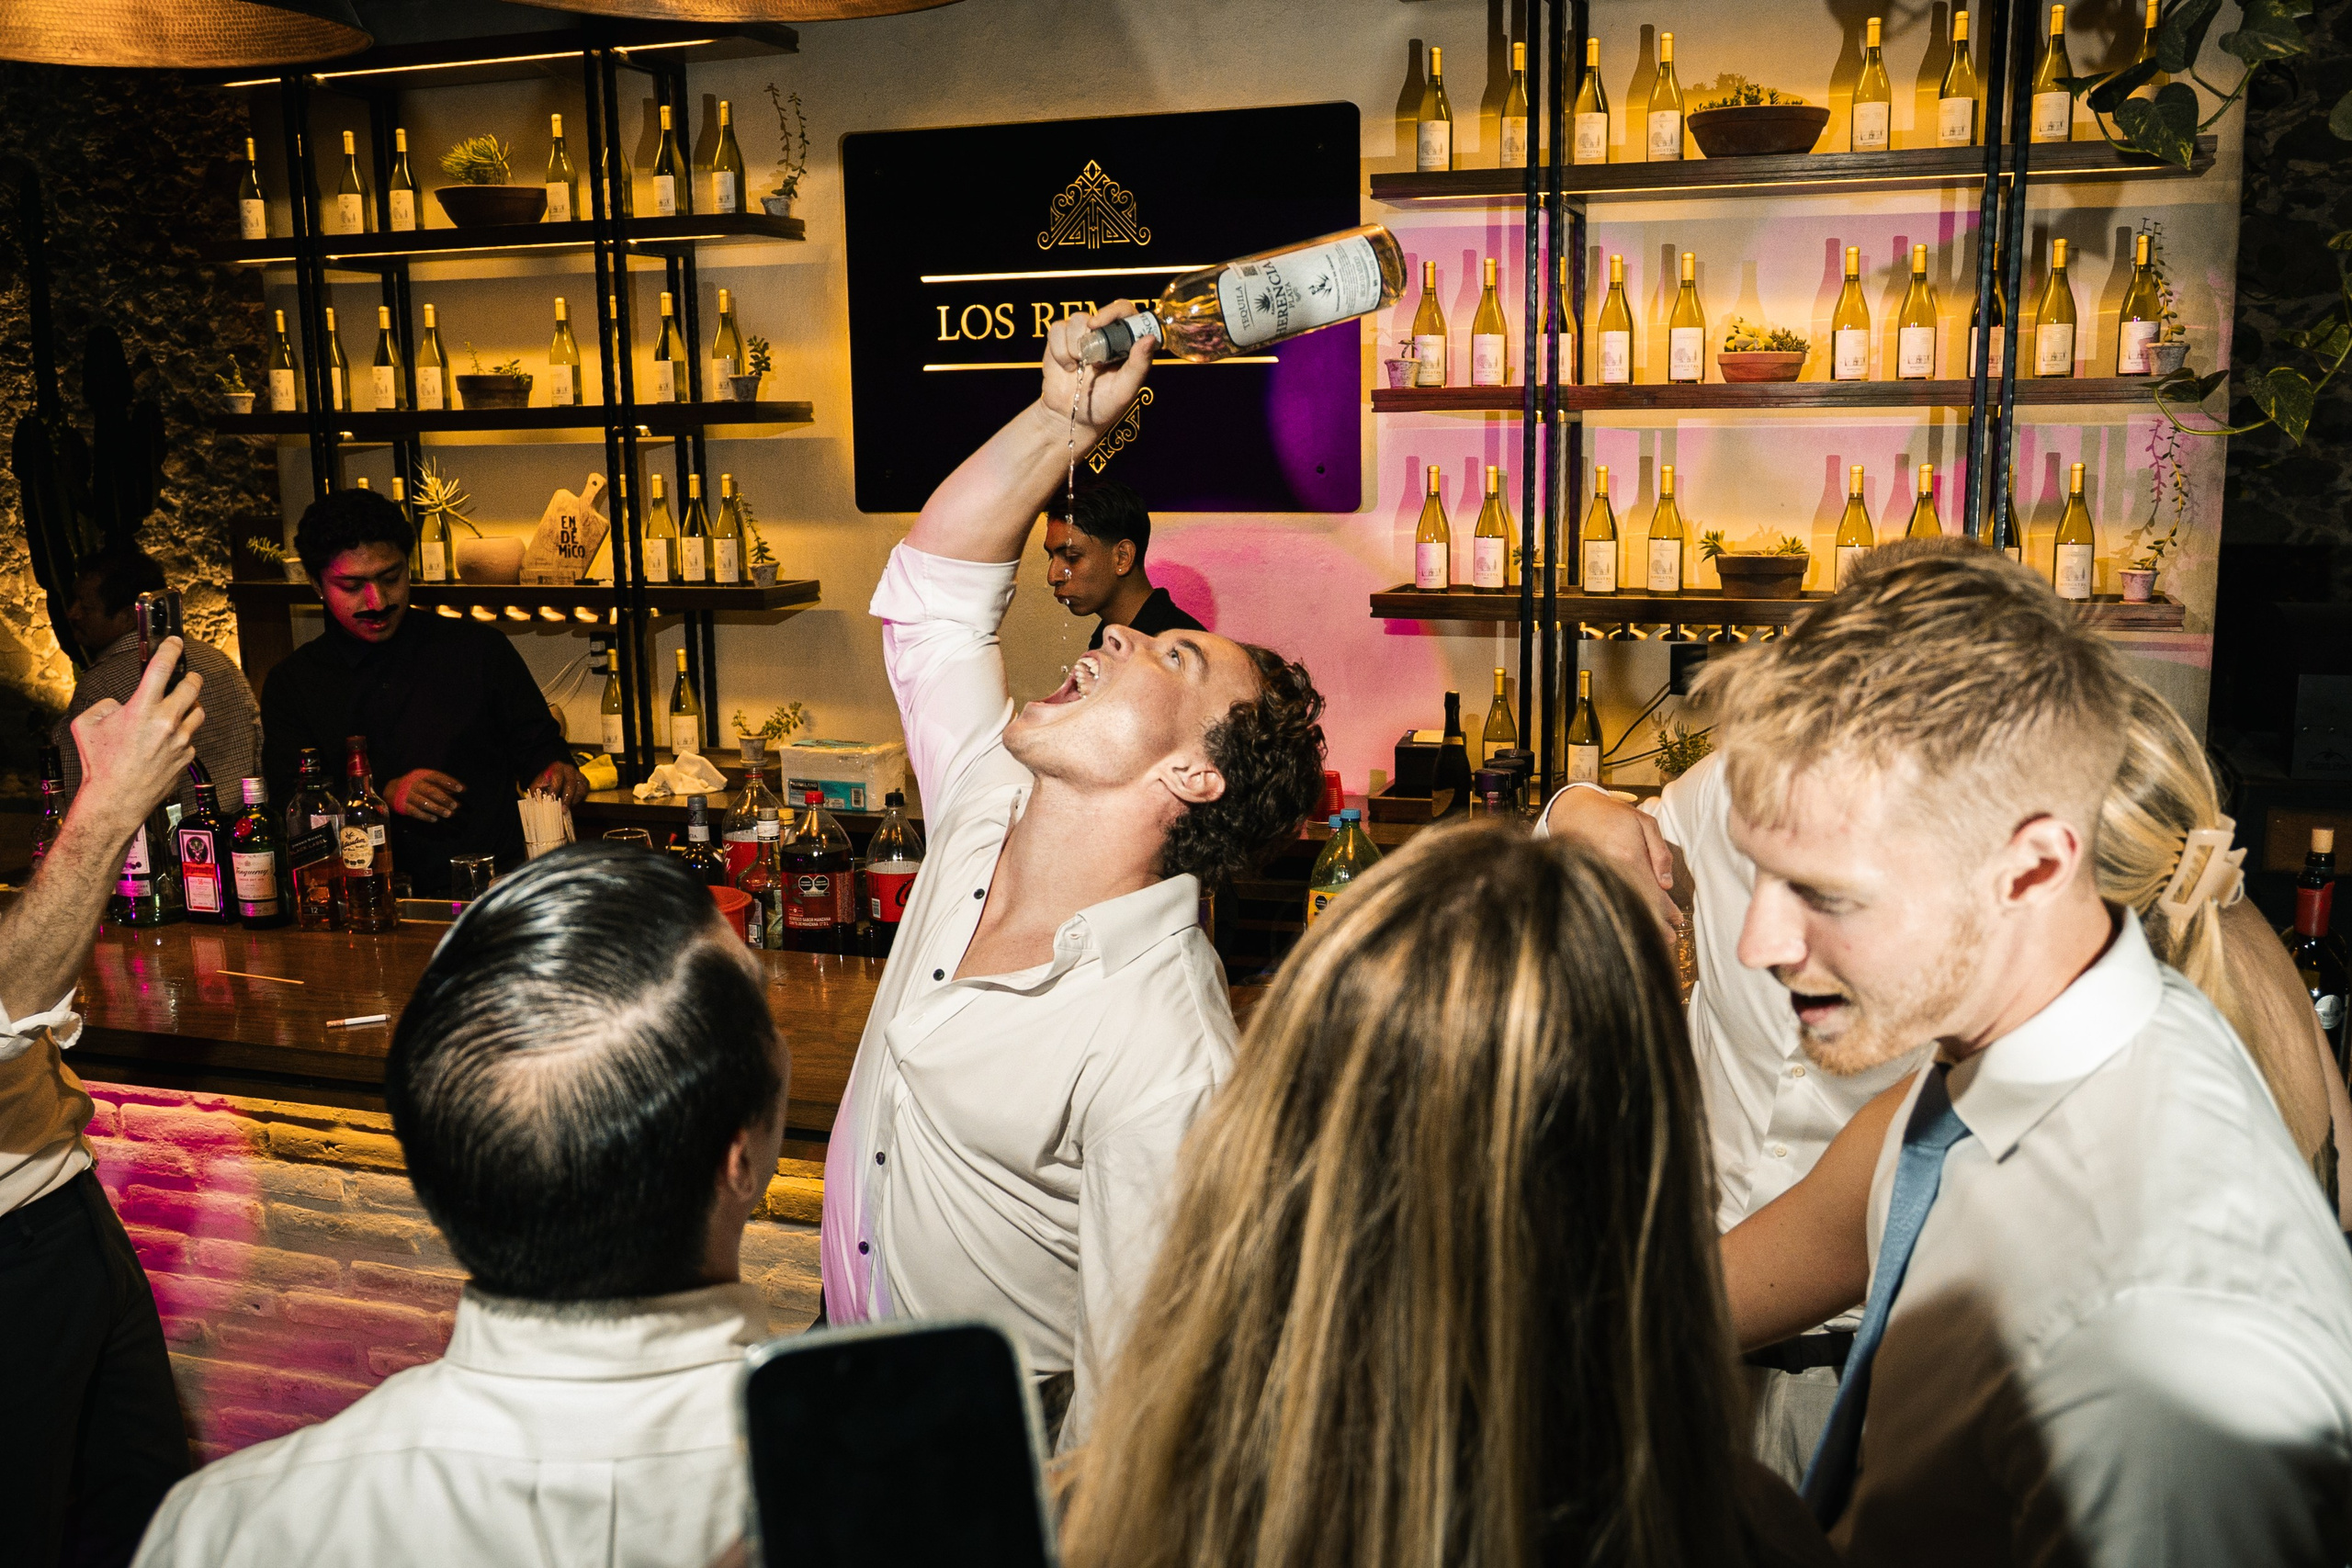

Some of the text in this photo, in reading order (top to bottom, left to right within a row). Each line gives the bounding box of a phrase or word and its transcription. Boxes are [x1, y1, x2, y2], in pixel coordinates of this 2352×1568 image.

[1235, 286, 1250, 331] TEQUILA
[1262, 261, 1289, 336] HERENCIA
[1284, 281, 1295, 309] PLATA
[937, 303, 1015, 341] LOS
[561, 516, 576, 529] EN
